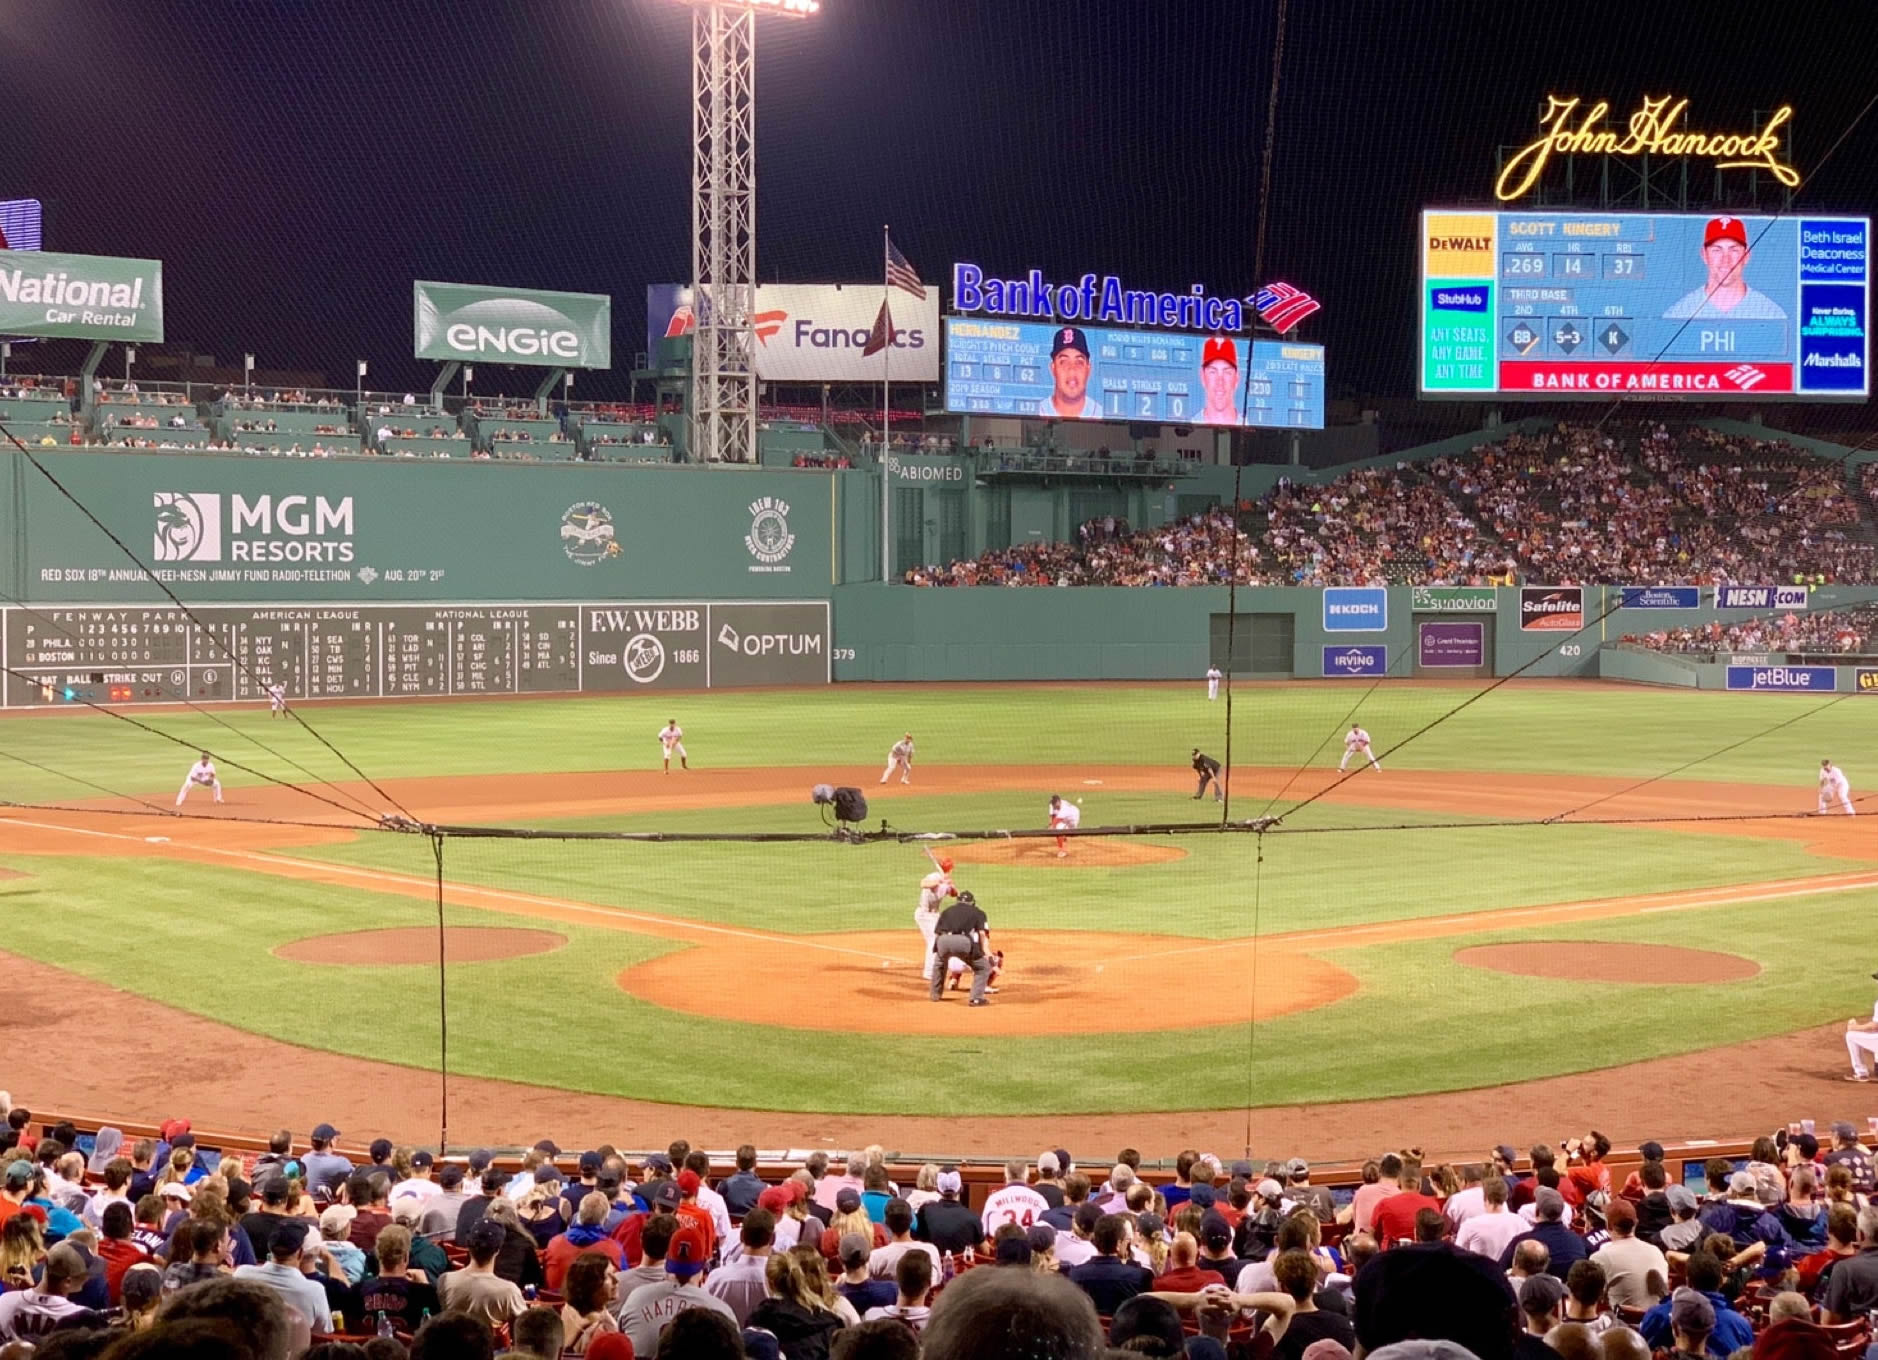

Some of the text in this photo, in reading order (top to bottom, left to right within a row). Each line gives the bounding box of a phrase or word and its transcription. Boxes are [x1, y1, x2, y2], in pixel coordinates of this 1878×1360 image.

[1496, 95, 1799, 200] John Hancock
[1509, 222, 1555, 235] SCOTT
[1803, 231, 1862, 244] Beth Israel
[1515, 243, 1533, 253] AVG
[1567, 243, 1580, 253] HR
[1801, 246, 1864, 260] Deaconess
[1505, 258, 1633, 275] .269 14 37
[1801, 263, 1865, 274] Medical Center
[0, 270, 143, 309] National
[1509, 289, 1568, 301] THIRD BASE
[953, 262, 1242, 332] Bank of America
[1437, 292, 1482, 307] StubHub
[1514, 305, 1624, 316] 2ND 4TH 6TH
[46, 308, 137, 327] Car Rental
[1809, 316, 1856, 327] ALWAYS
[1431, 327, 1450, 343] ANY
[1608, 332, 1617, 344] K
[1700, 331, 1735, 352] PHI
[1432, 346, 1451, 361] ANY
[1804, 352, 1861, 368] Marshalls
[1020, 369, 1034, 382] 62
[1435, 364, 1483, 379] ANY TIME
[1533, 373, 1720, 390] BANK OF AMERICA
[1142, 396, 1152, 416] 2
[900, 466, 963, 481] ABIOMED
[231, 493, 353, 535] MGM
[231, 540, 354, 562] RESORTS
[40, 568, 62, 581] RED
[65, 568, 86, 581] SOX
[108, 569, 148, 582] ANNUAL
[152, 569, 207, 582] WEEI-NESN
[208, 569, 241, 582] JIMMY
[243, 569, 270, 582] FUND
[272, 569, 351, 582] RADIO-TELETHON
[1430, 595, 1496, 610] sunovion
[1522, 600, 1581, 613] Safelite
[1639, 597, 1680, 609] Scientific
[435, 610, 529, 619] NATIONAL LEAGUE
[1342, 603, 1378, 615] KOCH
[53, 612, 188, 622] FENWAY PARK
[252, 611, 360, 620] AMERICAN LEAGUE
[590, 609, 699, 632] F.W. WEBB
[255, 636, 273, 645] NYY
[327, 635, 343, 644] SEA
[403, 635, 419, 643] TOR
[470, 634, 485, 642] COL
[539, 633, 549, 641] SD
[255, 646, 273, 655] OAK
[330, 645, 341, 654] TB
[403, 644, 419, 652] LAD
[472, 643, 485, 651] ARI
[743, 633, 821, 657] OPTUM
[1560, 645, 1581, 656] 420
[38, 652, 75, 663] BOSTON
[326, 655, 344, 664] CWS
[402, 653, 420, 662] WSH
[473, 652, 483, 661] SF
[537, 651, 550, 660] MIA
[588, 650, 699, 665] Since 1866
[833, 648, 855, 661] 379
[258, 656, 270, 665] KC
[470, 662, 487, 670] CHC
[537, 661, 550, 669] ATL
[1335, 655, 1375, 666] IRVING
[255, 666, 273, 675] BAL
[327, 665, 343, 674] MIN
[405, 663, 417, 671] PIT
[41, 675, 58, 684] BAT
[66, 674, 92, 685] BALL
[103, 673, 137, 684] STRIKE
[141, 673, 163, 683] OUT
[326, 675, 344, 684] DET
[403, 673, 419, 682] CLE
[1751, 667, 1808, 688] jetBlue
[326, 685, 344, 694] HOU
[402, 683, 420, 692] NYM
[471, 681, 486, 690] STL
[1002, 1208, 1033, 1227] 34
